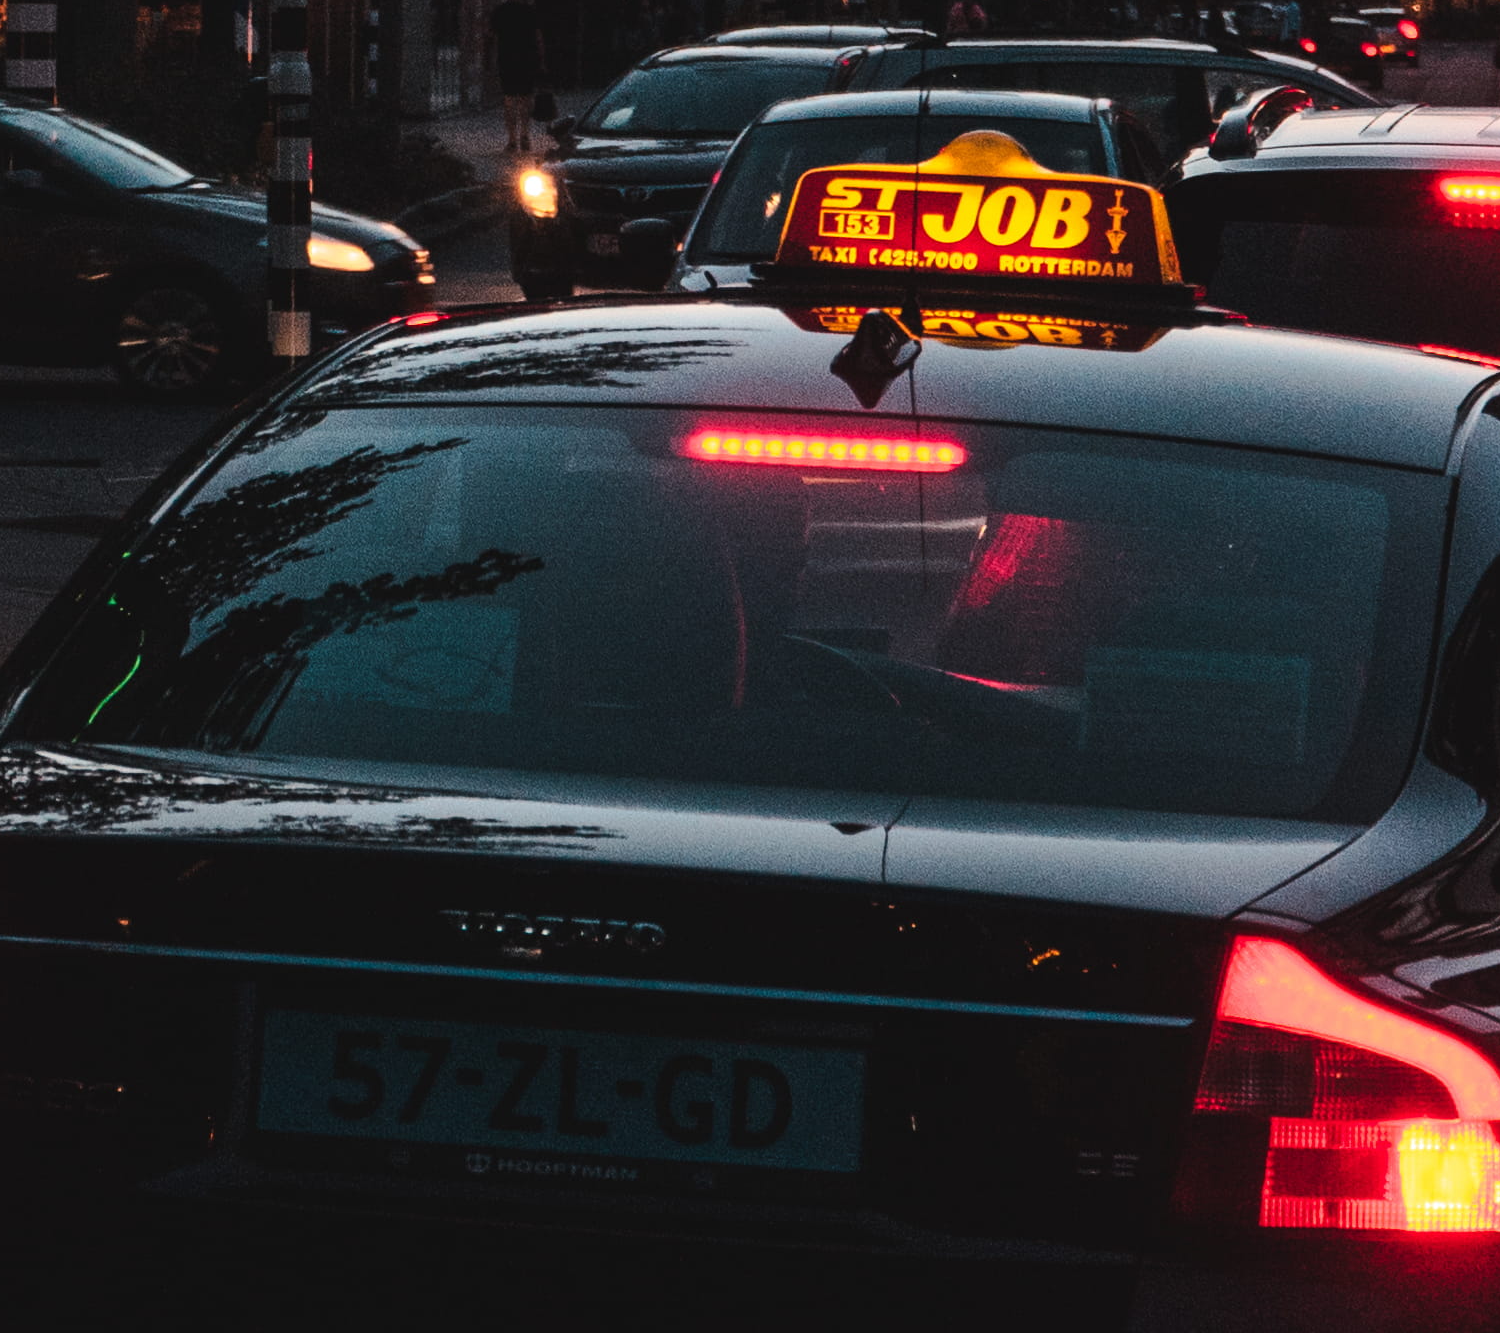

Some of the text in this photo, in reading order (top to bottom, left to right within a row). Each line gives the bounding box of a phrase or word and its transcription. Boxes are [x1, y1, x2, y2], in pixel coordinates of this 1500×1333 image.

[834, 213, 880, 236] 153
[922, 184, 1092, 249] JOB
[809, 245, 857, 264] TAXI
[999, 253, 1134, 279] ROTTERDAM
[328, 1030, 792, 1150] 57-ZL-GD
